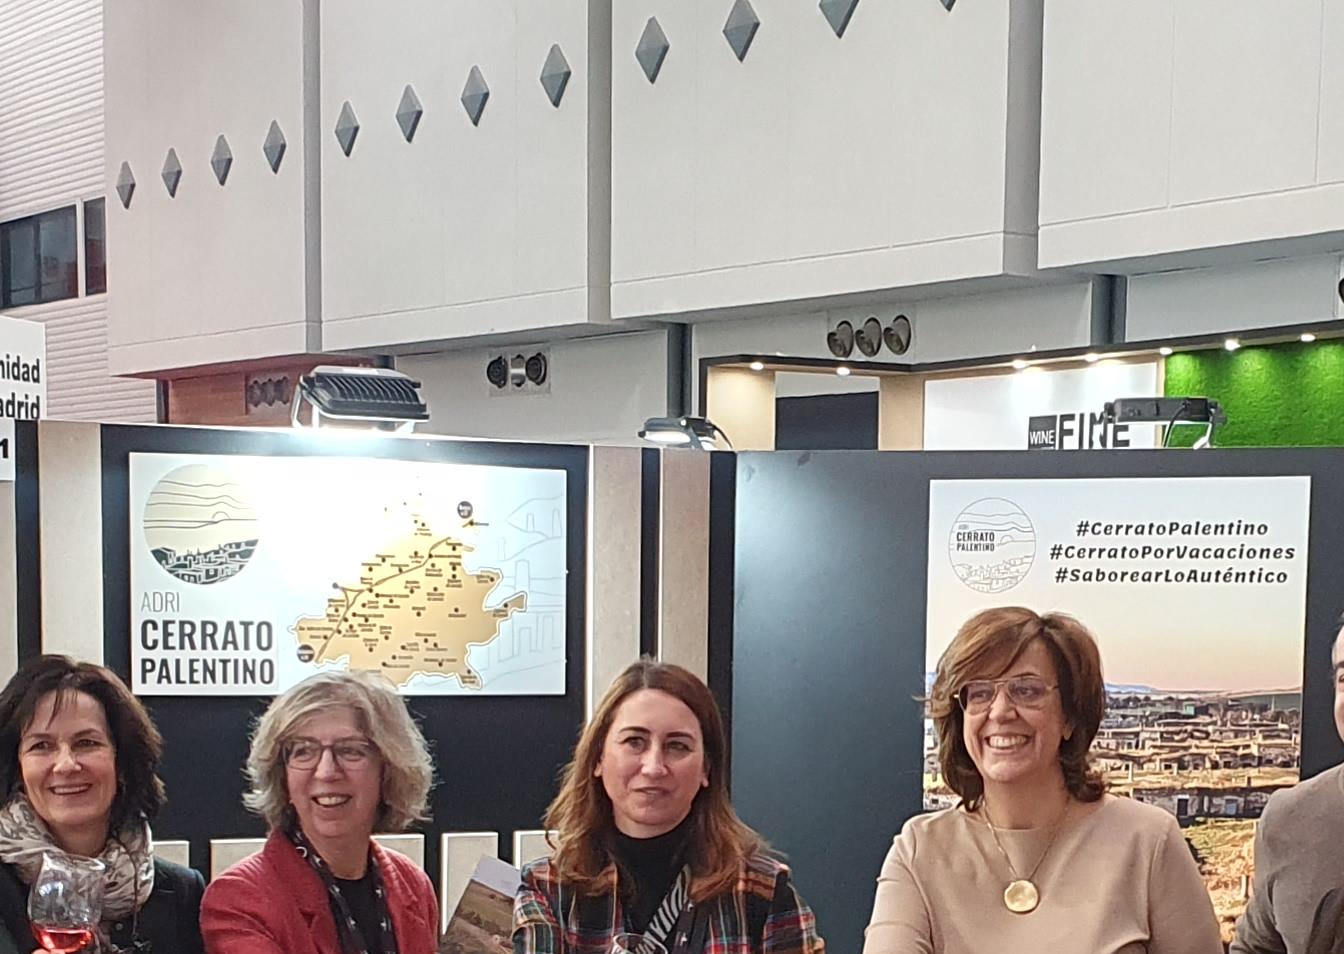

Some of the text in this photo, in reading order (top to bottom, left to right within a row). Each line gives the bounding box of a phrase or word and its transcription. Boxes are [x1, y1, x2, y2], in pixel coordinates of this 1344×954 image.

[1029, 430, 1055, 445] WINE
[956, 531, 995, 542] CERRATO
[1076, 520, 1269, 537] #CerratoPalentino
[956, 543, 995, 552] PALENTINO
[1049, 543, 1296, 561] #CerratoPorVacaciones
[1055, 567, 1288, 583] #SaborearLoAuténtico
[141, 592, 180, 612] ADRI
[141, 619, 273, 651] CERRATO
[141, 658, 274, 684] PALENTINO
